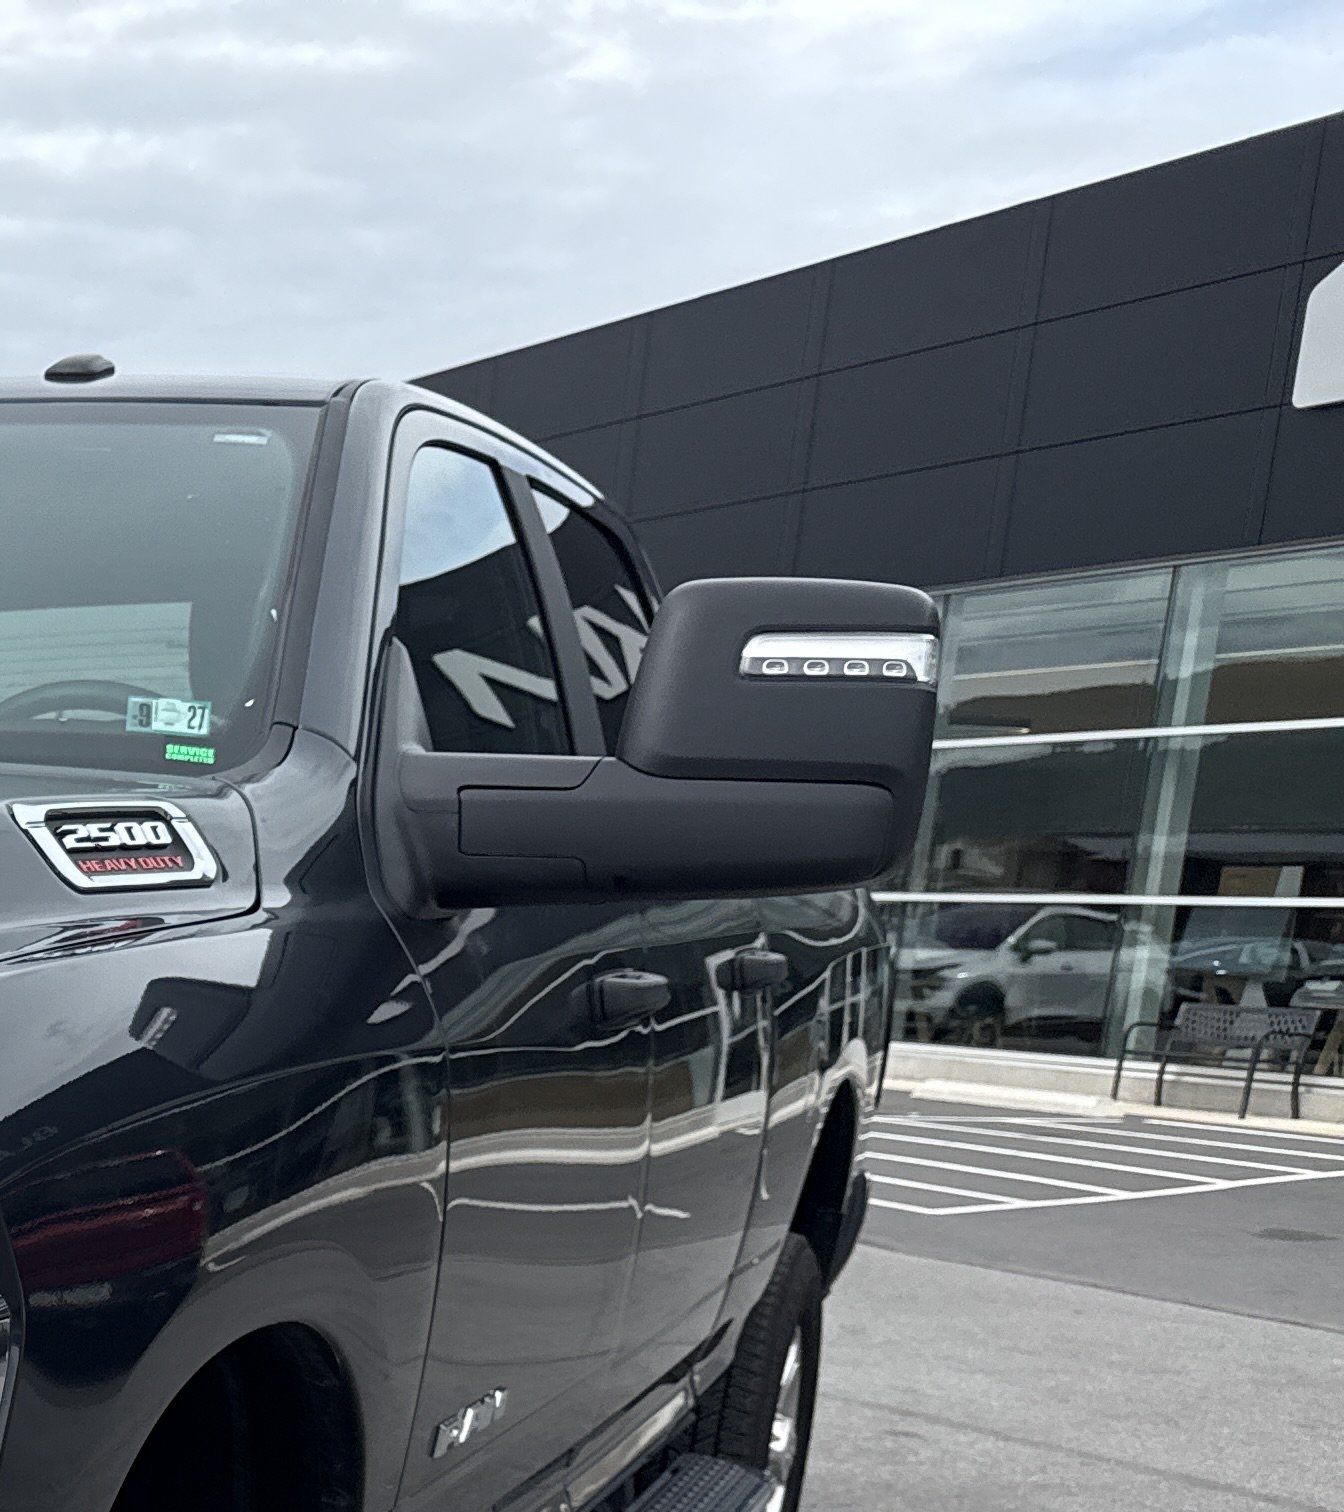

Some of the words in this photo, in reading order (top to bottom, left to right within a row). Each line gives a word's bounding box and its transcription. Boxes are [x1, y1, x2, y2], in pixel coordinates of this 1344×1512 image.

[187, 705, 207, 731] 27
[165, 744, 215, 757] SERVICE
[56, 821, 173, 852] 2500
[78, 857, 136, 872] HEAVY
[138, 856, 184, 870] DUTY
